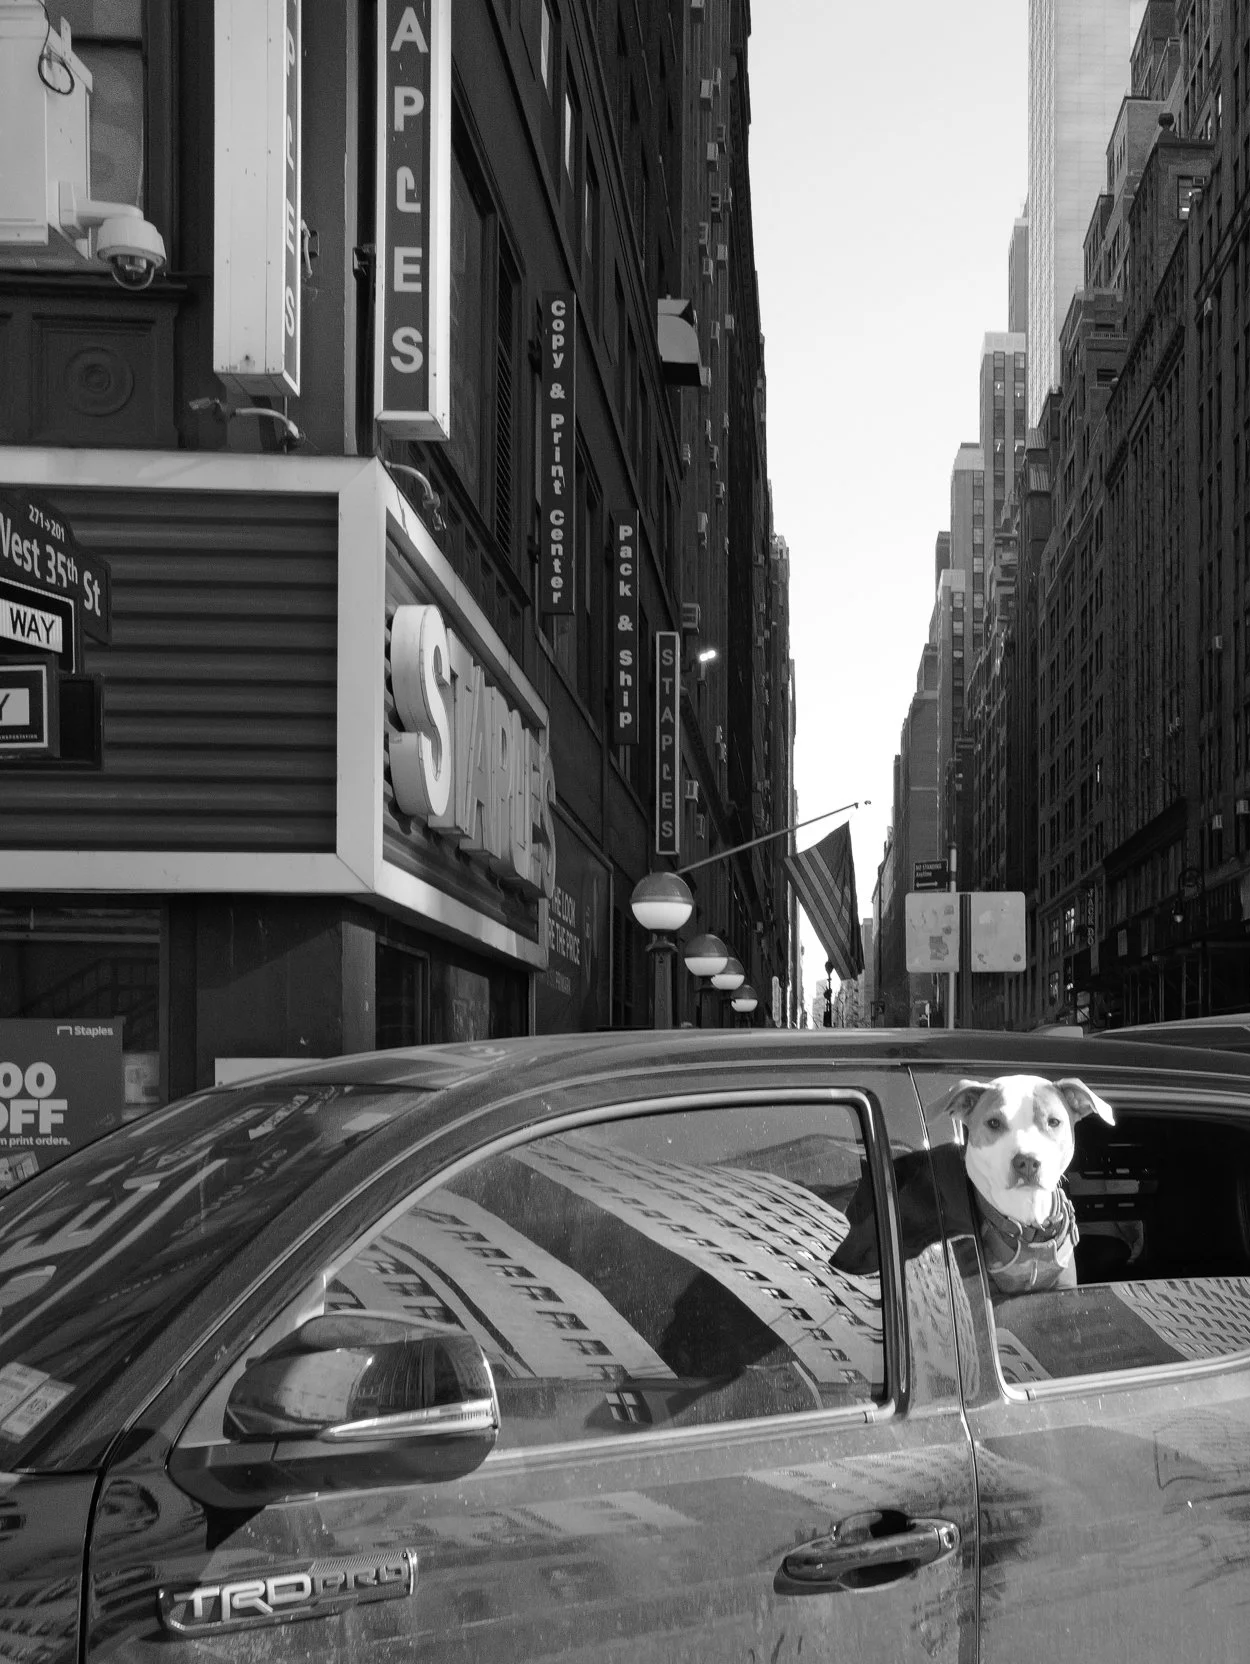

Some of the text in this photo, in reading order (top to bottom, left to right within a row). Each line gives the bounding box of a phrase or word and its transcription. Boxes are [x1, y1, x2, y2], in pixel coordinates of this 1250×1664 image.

[549, 299, 566, 604] Copy & Print Center
[29, 504, 65, 542] 271 201
[45, 544, 79, 588] 35th
[83, 570, 101, 616] St
[10, 606, 55, 645] WAY
[618, 524, 633, 728] Pack & Ship
[389, 604, 556, 900] STAPLES
[660, 649, 674, 839] STAPLES
[74, 1025, 114, 1038] Staples
[0, 1099, 68, 1135] FF
[9, 1136, 34, 1148] print
[173, 1561, 409, 1623] TRD PRO
